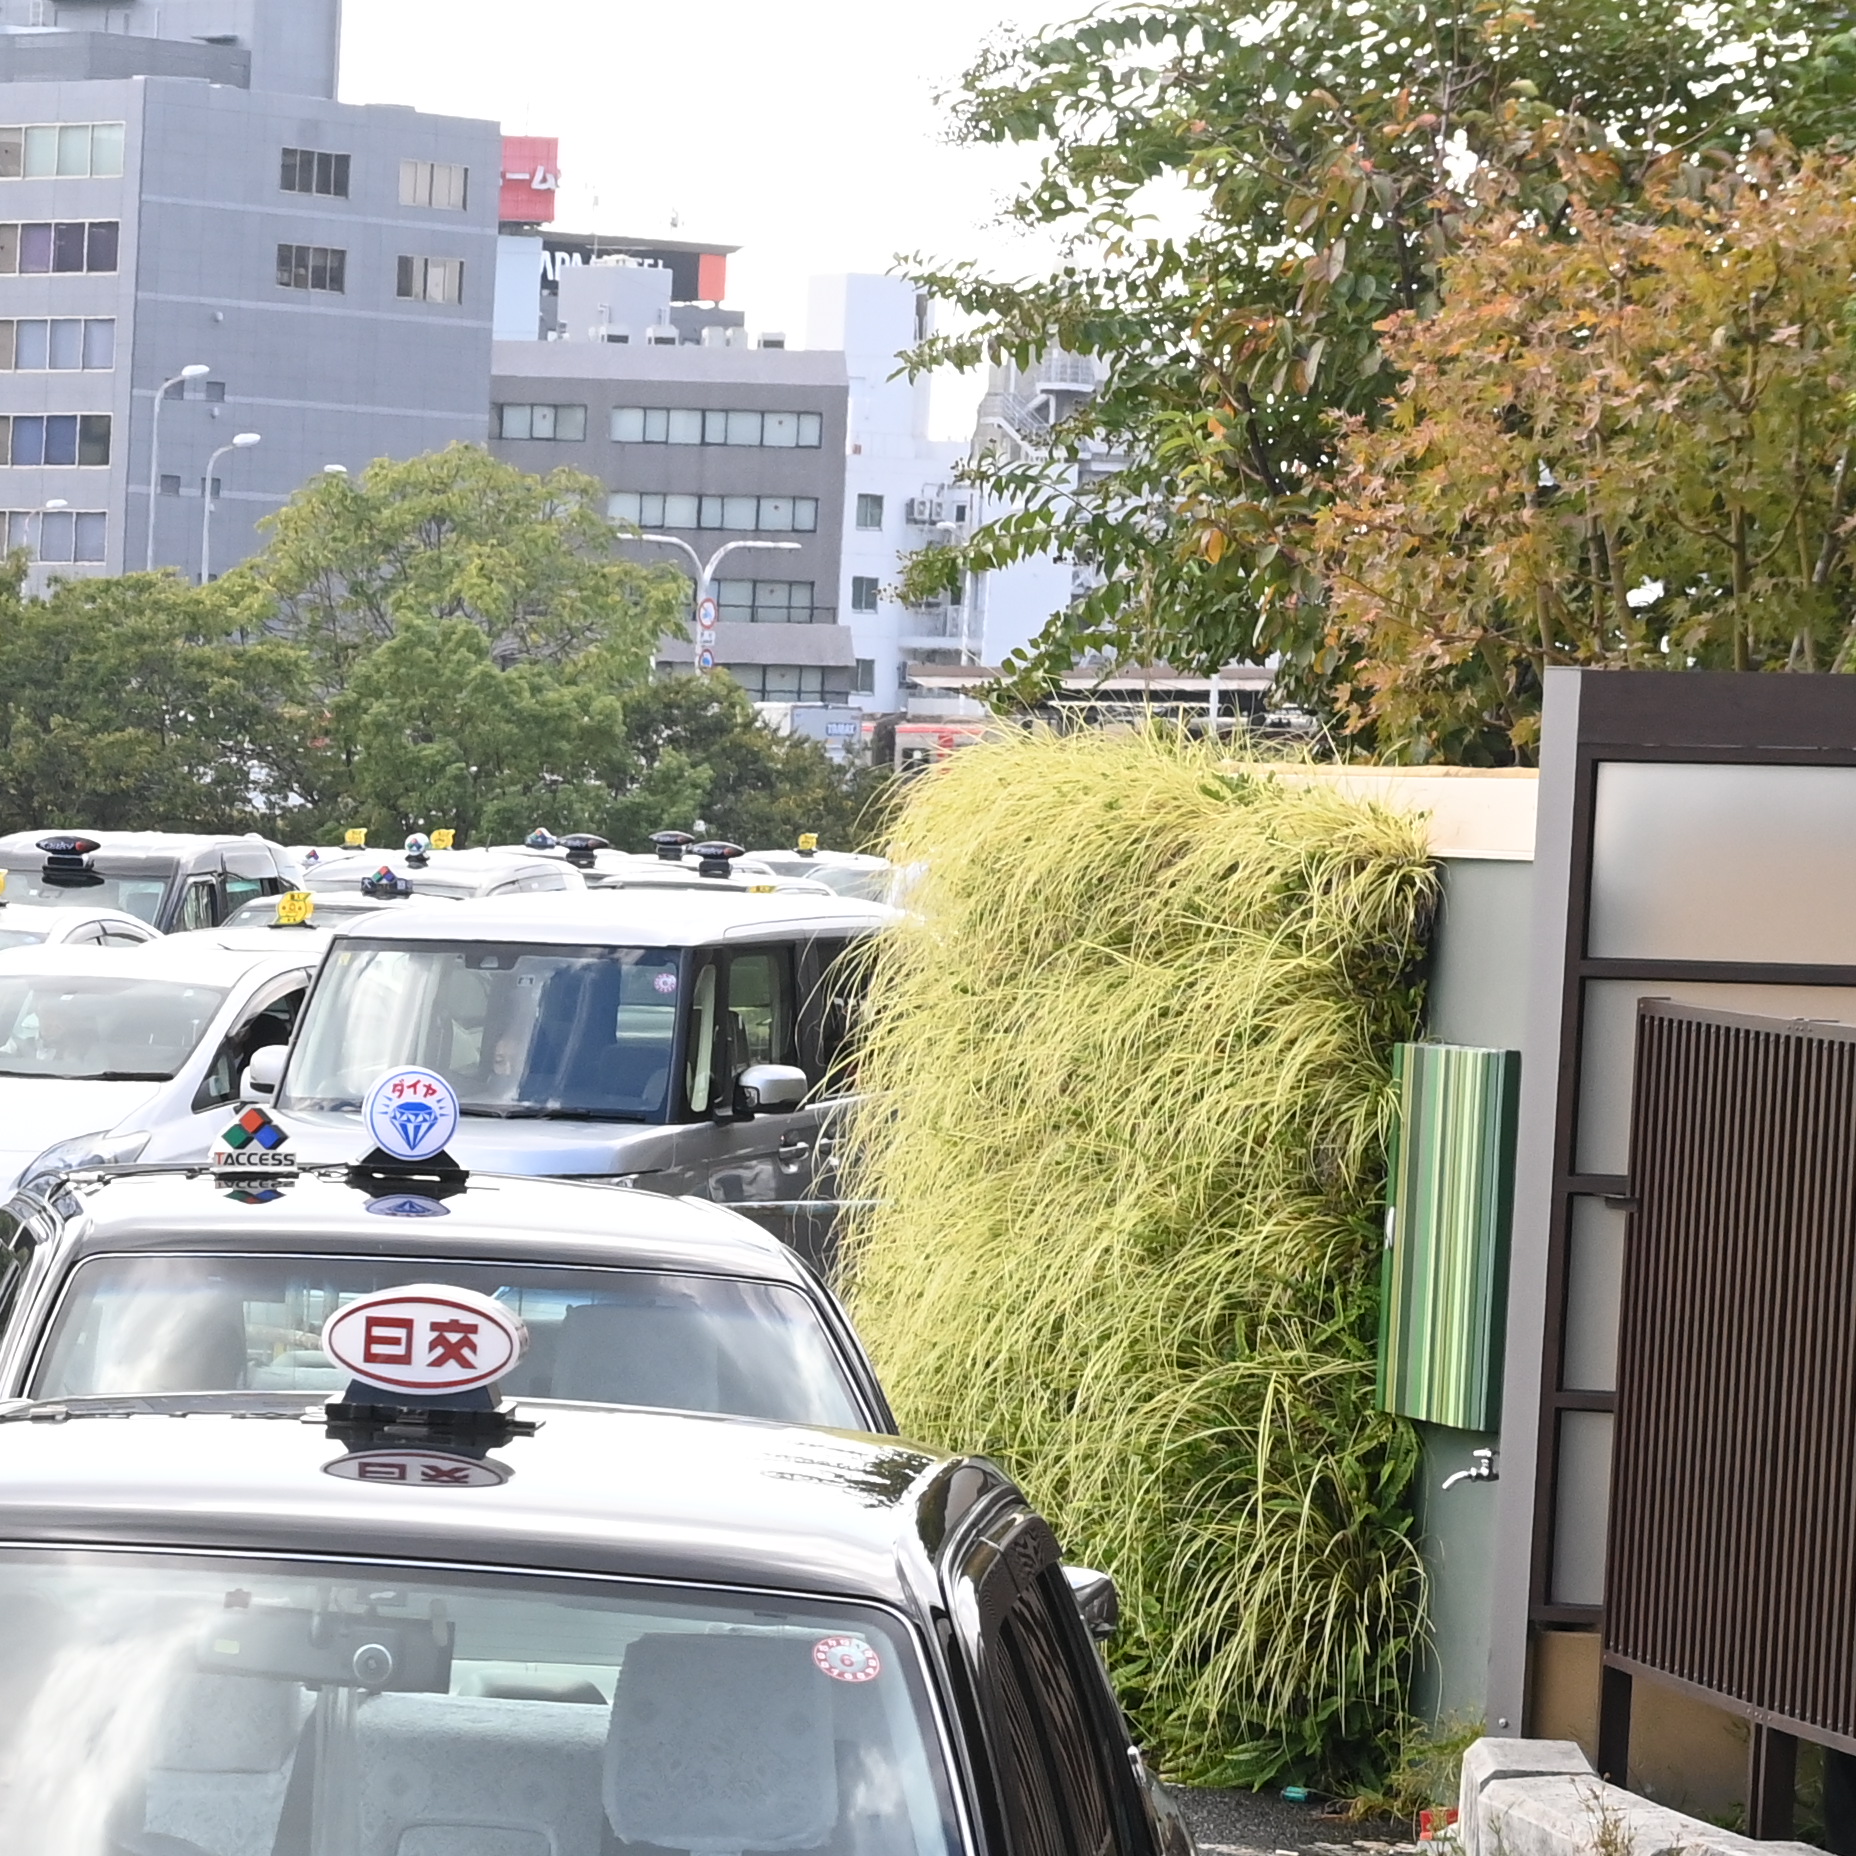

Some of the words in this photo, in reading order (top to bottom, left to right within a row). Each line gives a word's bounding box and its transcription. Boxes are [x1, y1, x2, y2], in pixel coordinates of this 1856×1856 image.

[500, 165, 560, 190] ーム
[391, 1078, 438, 1099] ダイヤ
[214, 1151, 295, 1168] TACCESS
[363, 1315, 480, 1370] 日交
